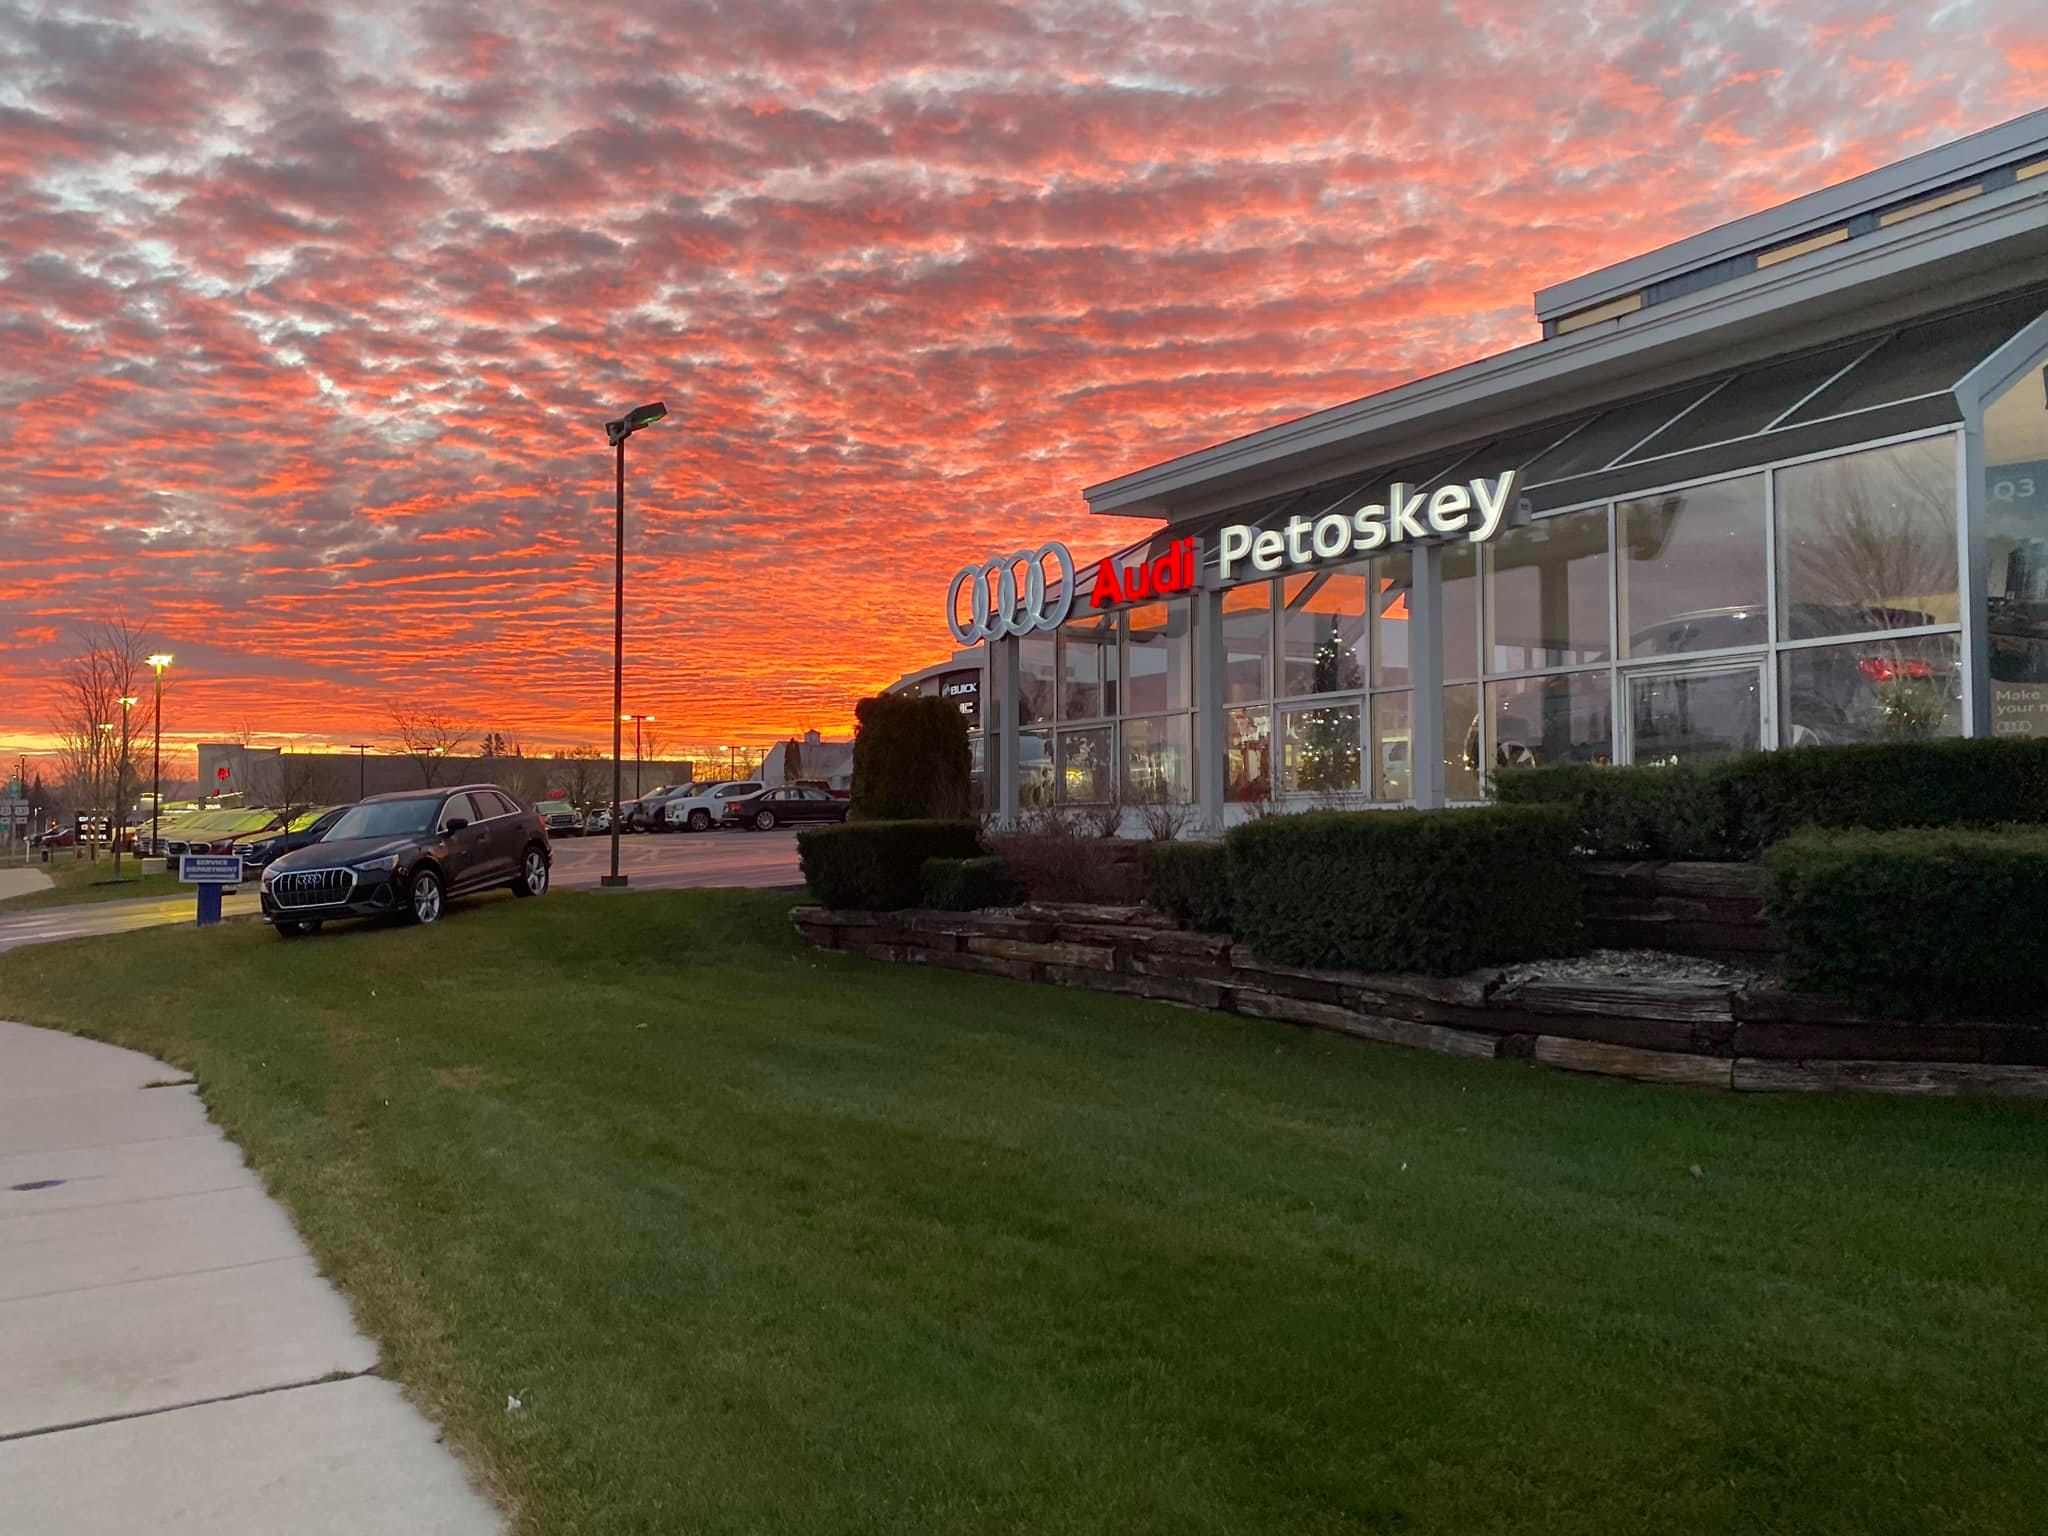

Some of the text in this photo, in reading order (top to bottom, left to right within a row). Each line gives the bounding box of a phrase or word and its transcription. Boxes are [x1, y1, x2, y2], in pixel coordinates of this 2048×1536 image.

[1993, 478, 2036, 500] Q3
[1090, 470, 1516, 608] Audi Petoskey
[950, 682, 977, 696] BUICK
[1996, 690, 2041, 701] Make
[1997, 702, 2034, 716] your
